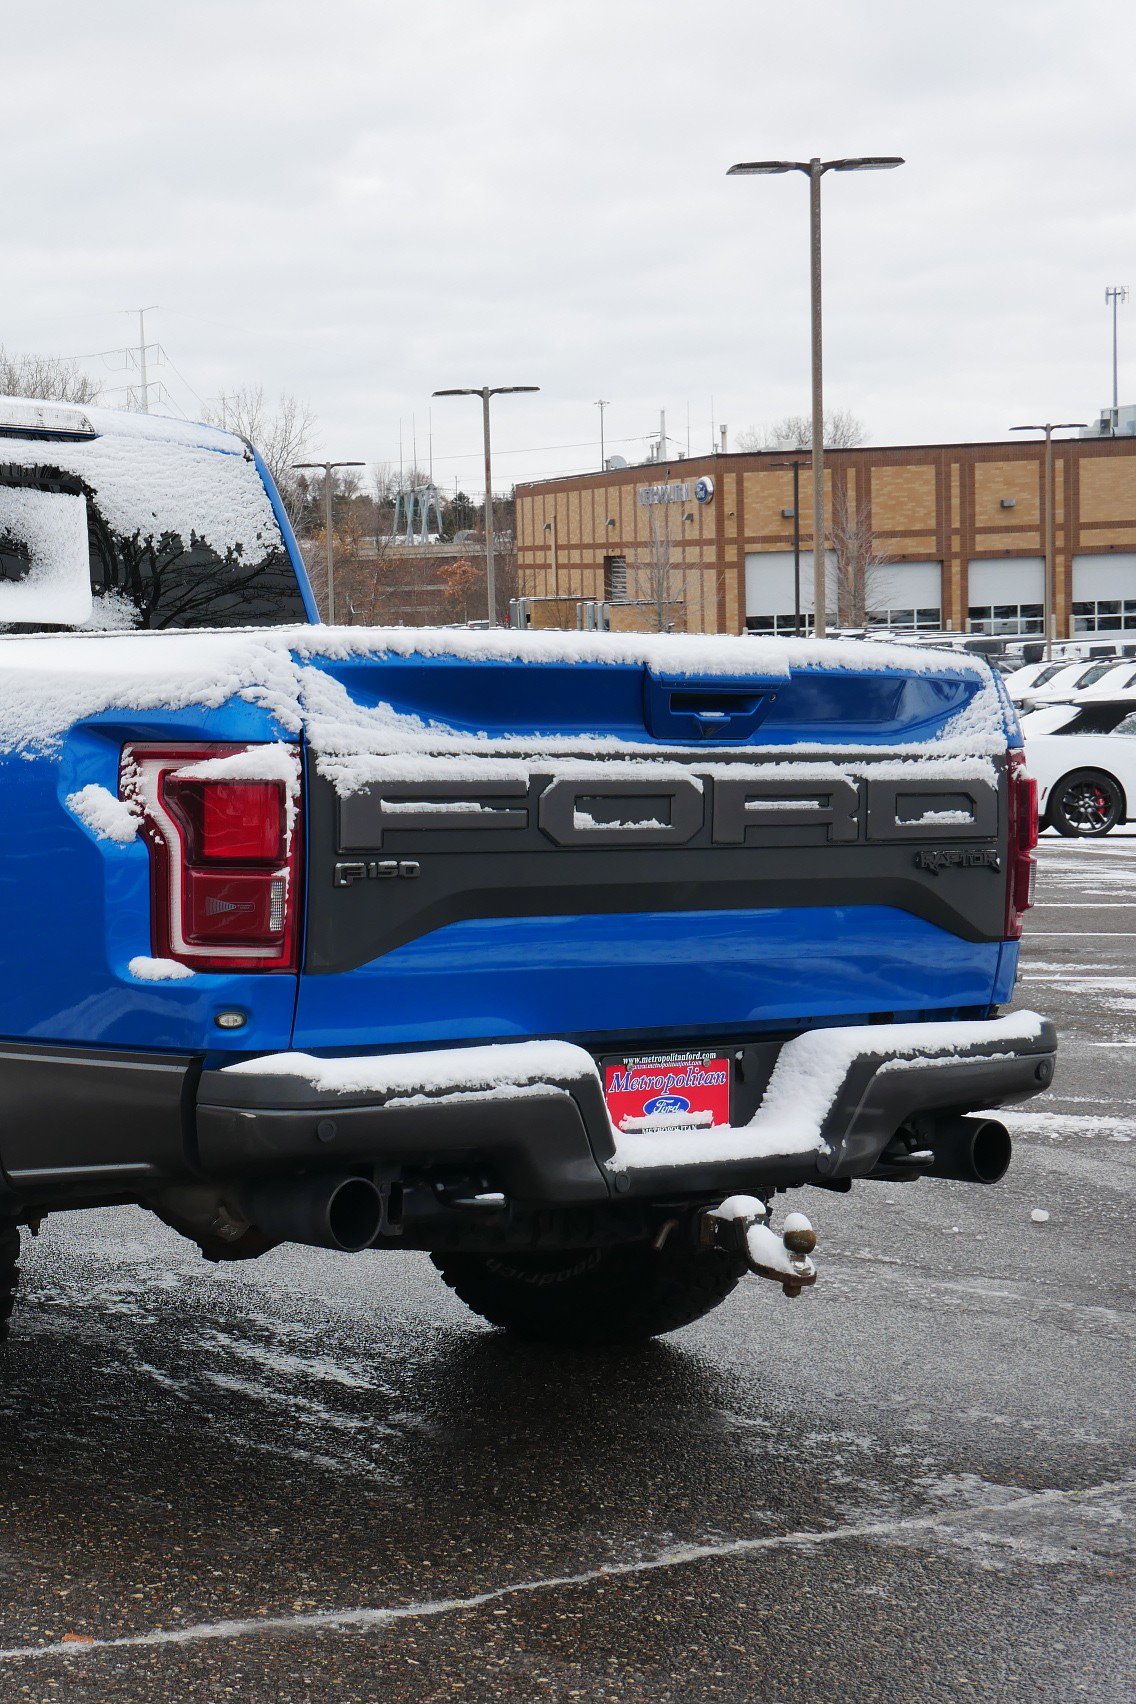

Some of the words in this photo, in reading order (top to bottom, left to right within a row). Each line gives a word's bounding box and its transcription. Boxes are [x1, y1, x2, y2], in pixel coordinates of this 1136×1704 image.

[338, 775, 998, 853] FORD
[920, 850, 1001, 874] RAPTOR
[623, 1052, 716, 1064] www.metropolitanford.com
[608, 1067, 727, 1094] Metropolitan
